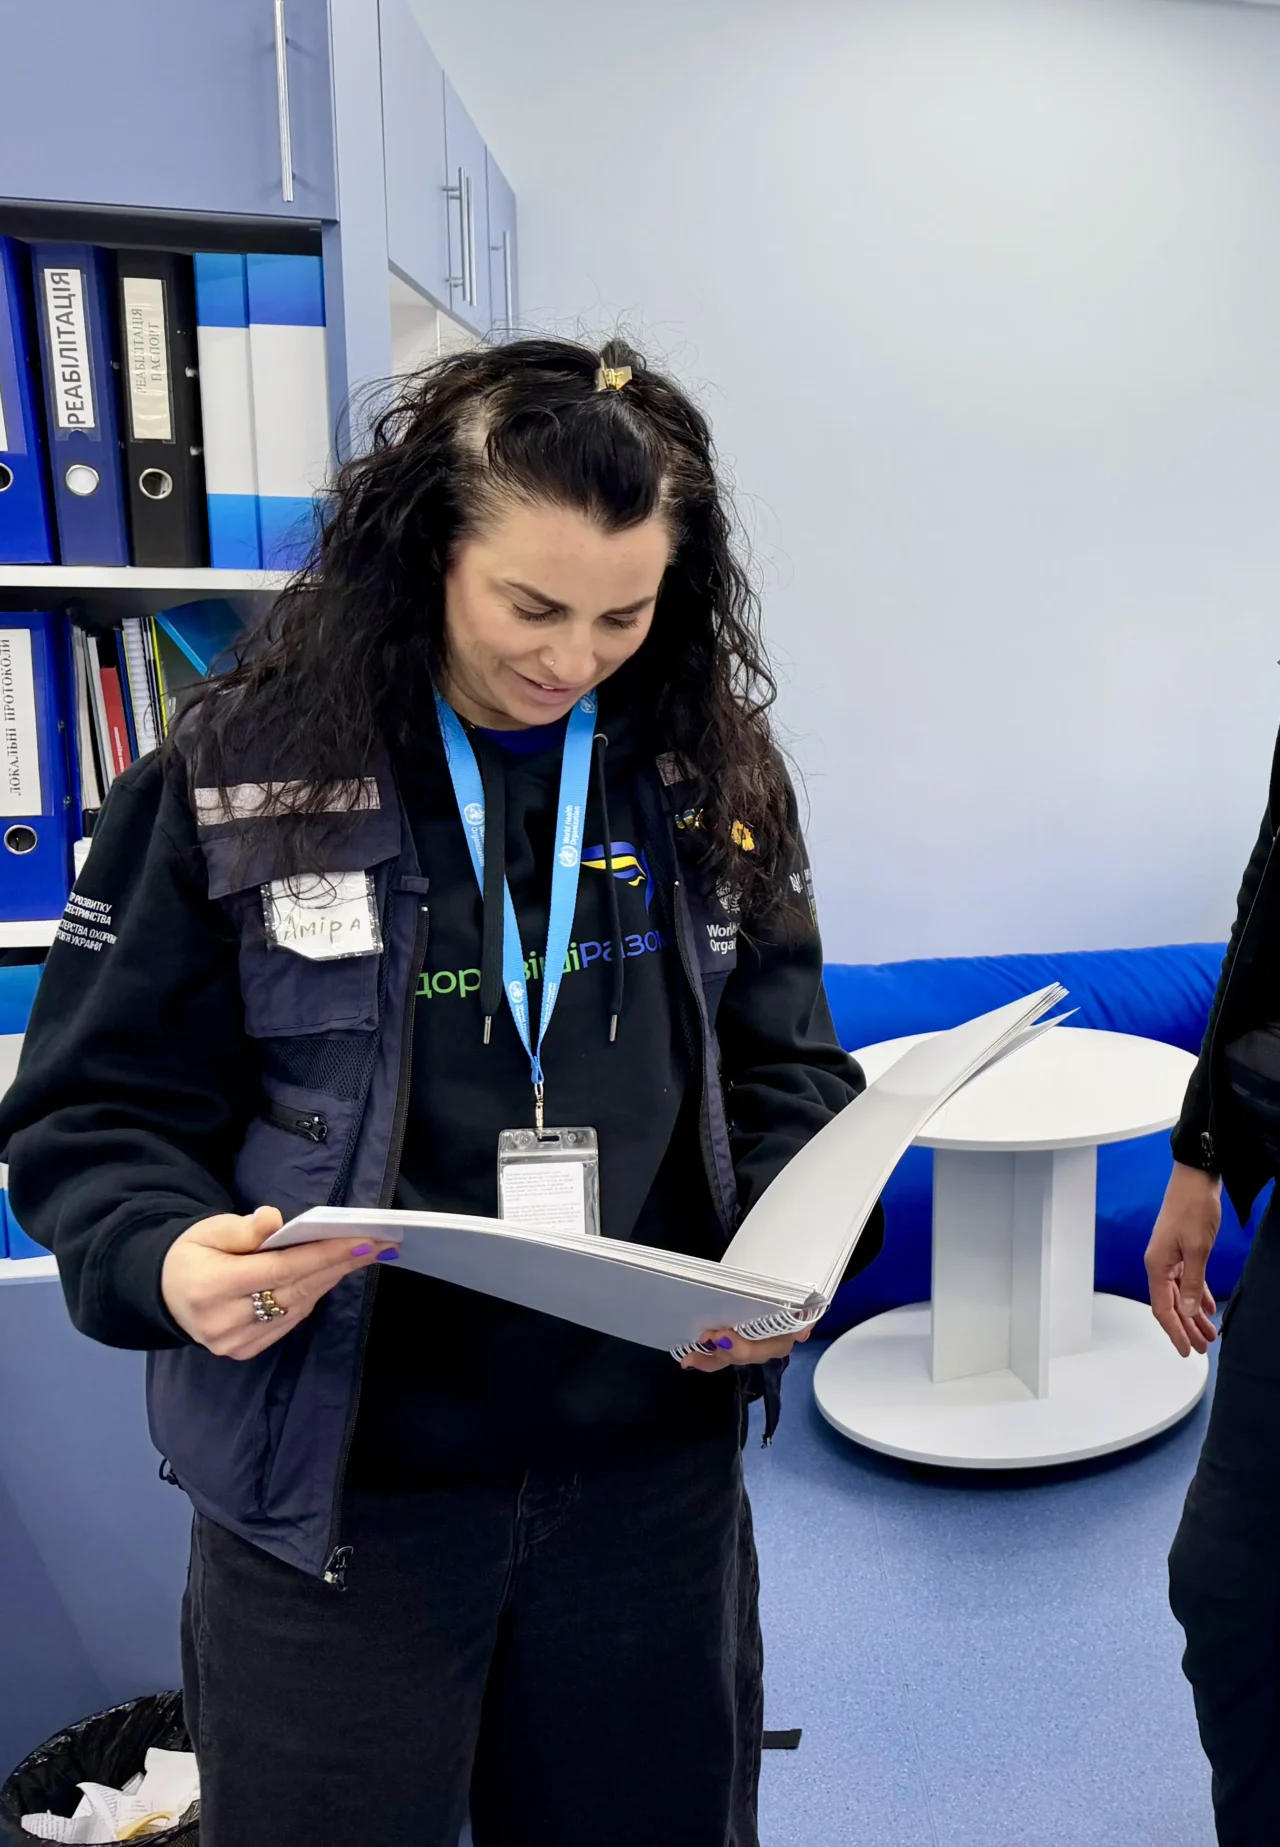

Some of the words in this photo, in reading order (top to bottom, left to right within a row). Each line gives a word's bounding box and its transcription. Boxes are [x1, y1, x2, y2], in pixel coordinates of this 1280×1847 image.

[51, 271, 86, 426] РЕАБІЛІТАЦІЯ
[5, 728, 21, 796] ЛОКАЛЬНІ
[74, 894, 113, 913] РОЗВИТКУ
[710, 938, 737, 955] Orga
